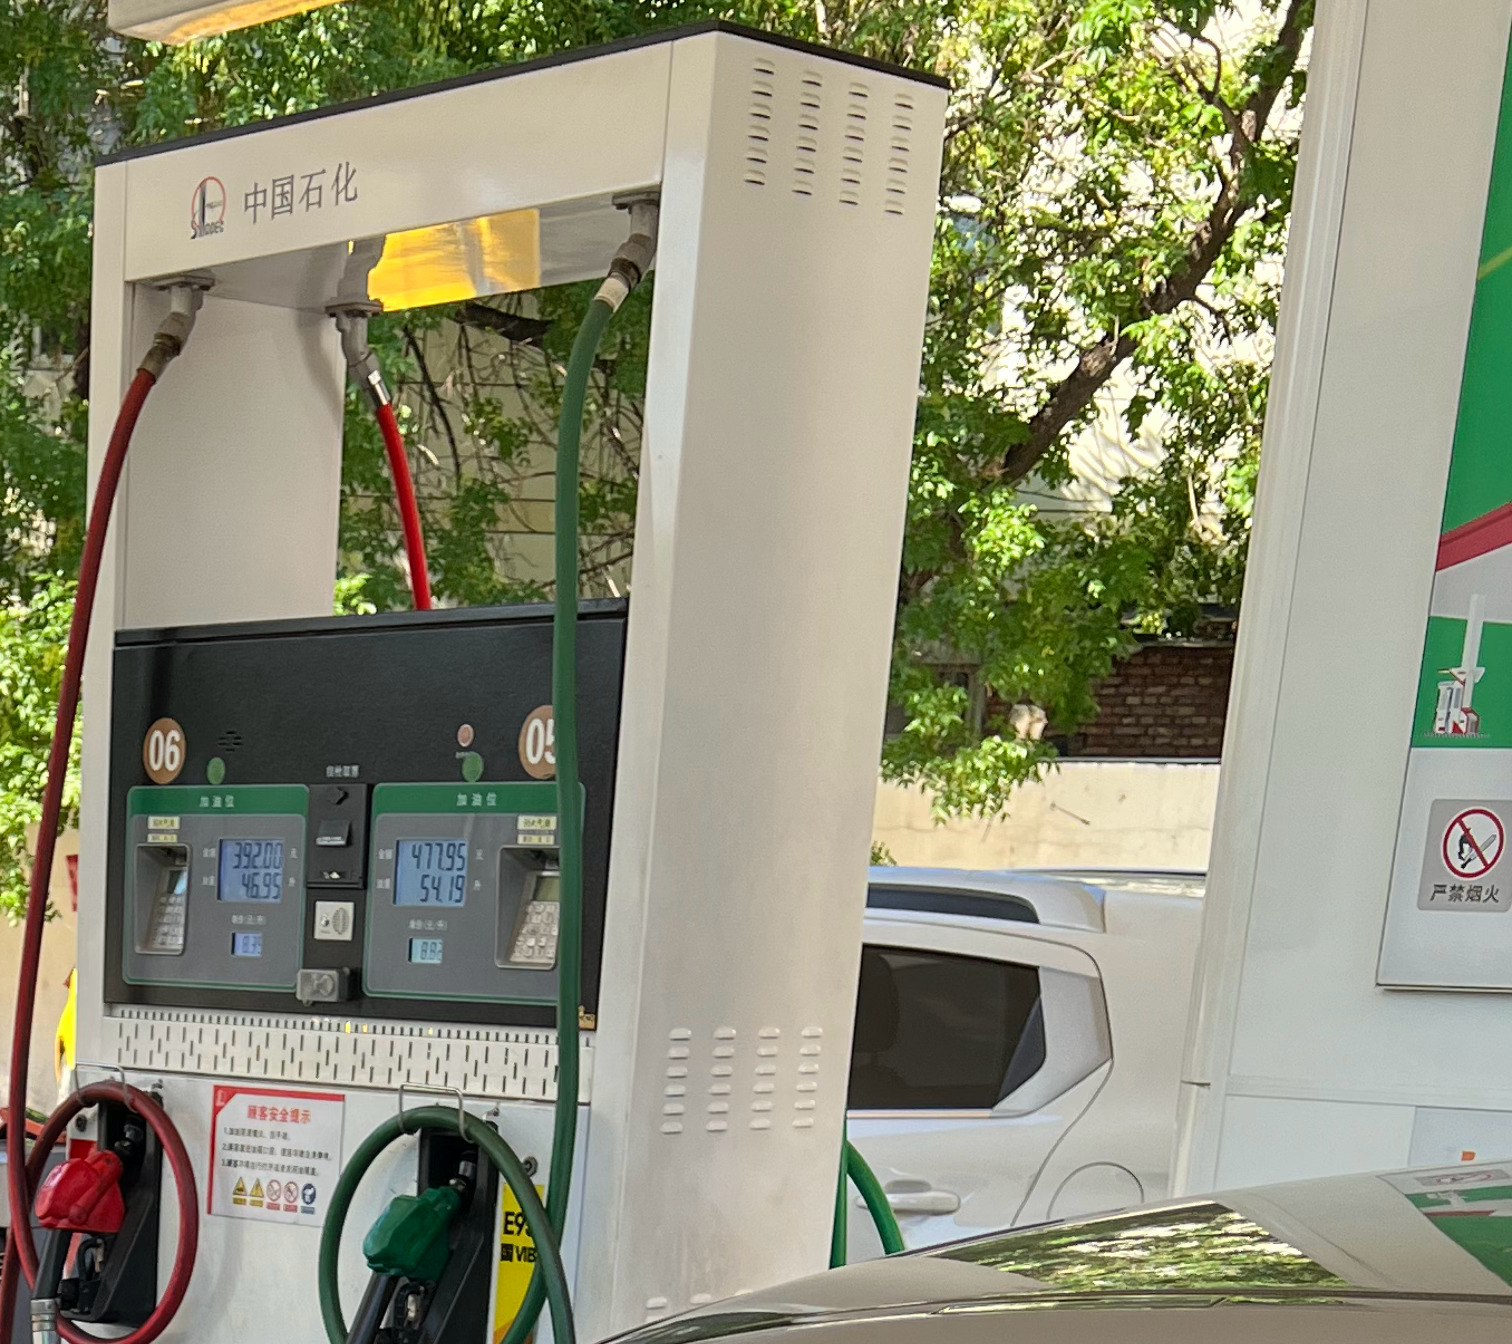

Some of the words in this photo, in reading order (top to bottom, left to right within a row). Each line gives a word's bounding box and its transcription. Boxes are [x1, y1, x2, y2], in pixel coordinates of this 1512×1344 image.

[244, 161, 358, 225] 中国石化
[149, 729, 180, 771] 06
[1430, 884, 1499, 903] 严禁烟火
